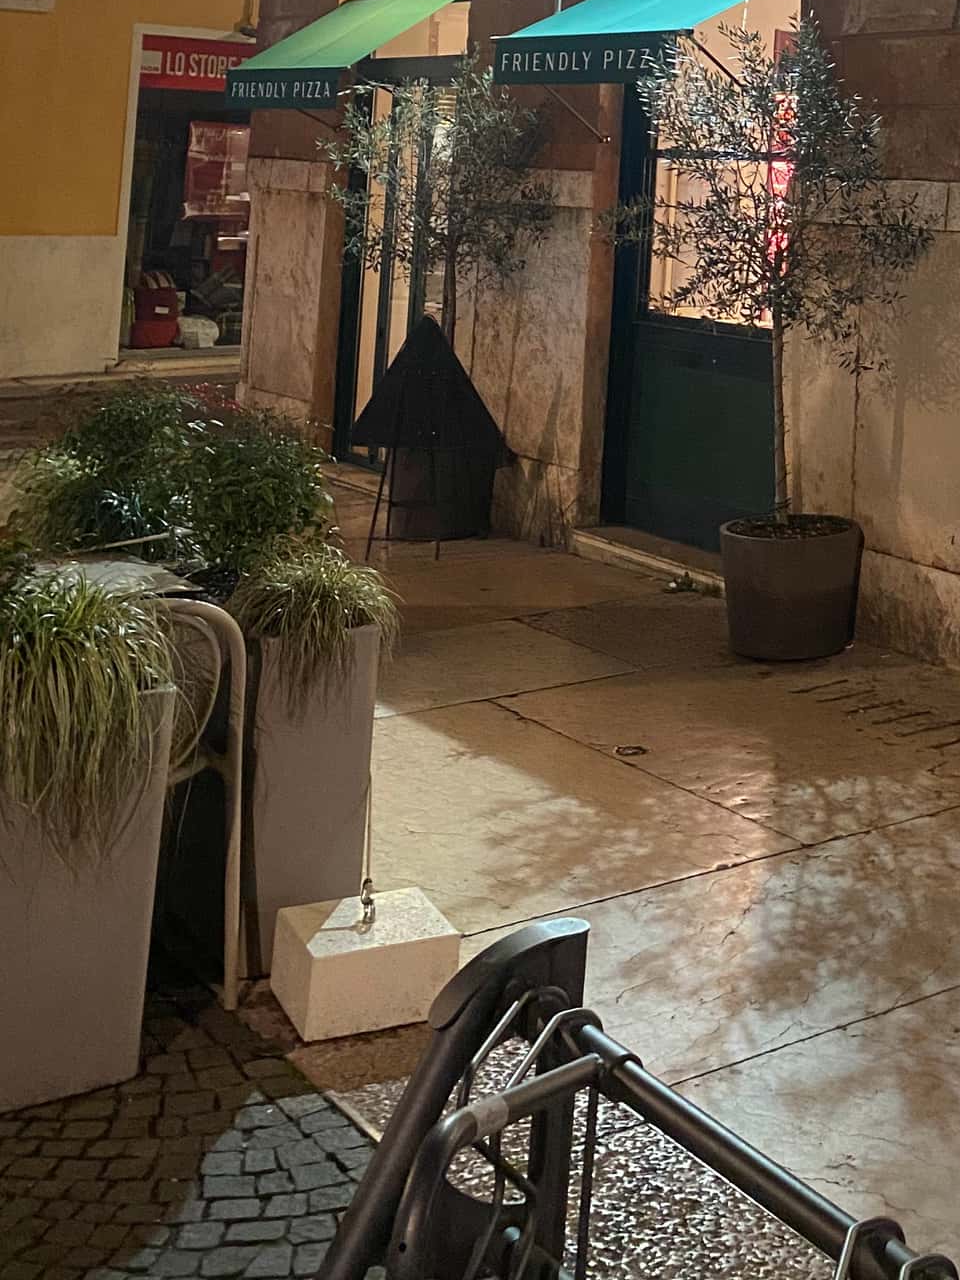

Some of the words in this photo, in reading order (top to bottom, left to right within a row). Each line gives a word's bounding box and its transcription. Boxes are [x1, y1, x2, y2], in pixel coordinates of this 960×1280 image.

[166, 51, 186, 76] LO
[501, 51, 592, 72] FRIENDLY
[231, 81, 288, 98] FRIENDLY
[292, 81, 331, 98] PIZZA
